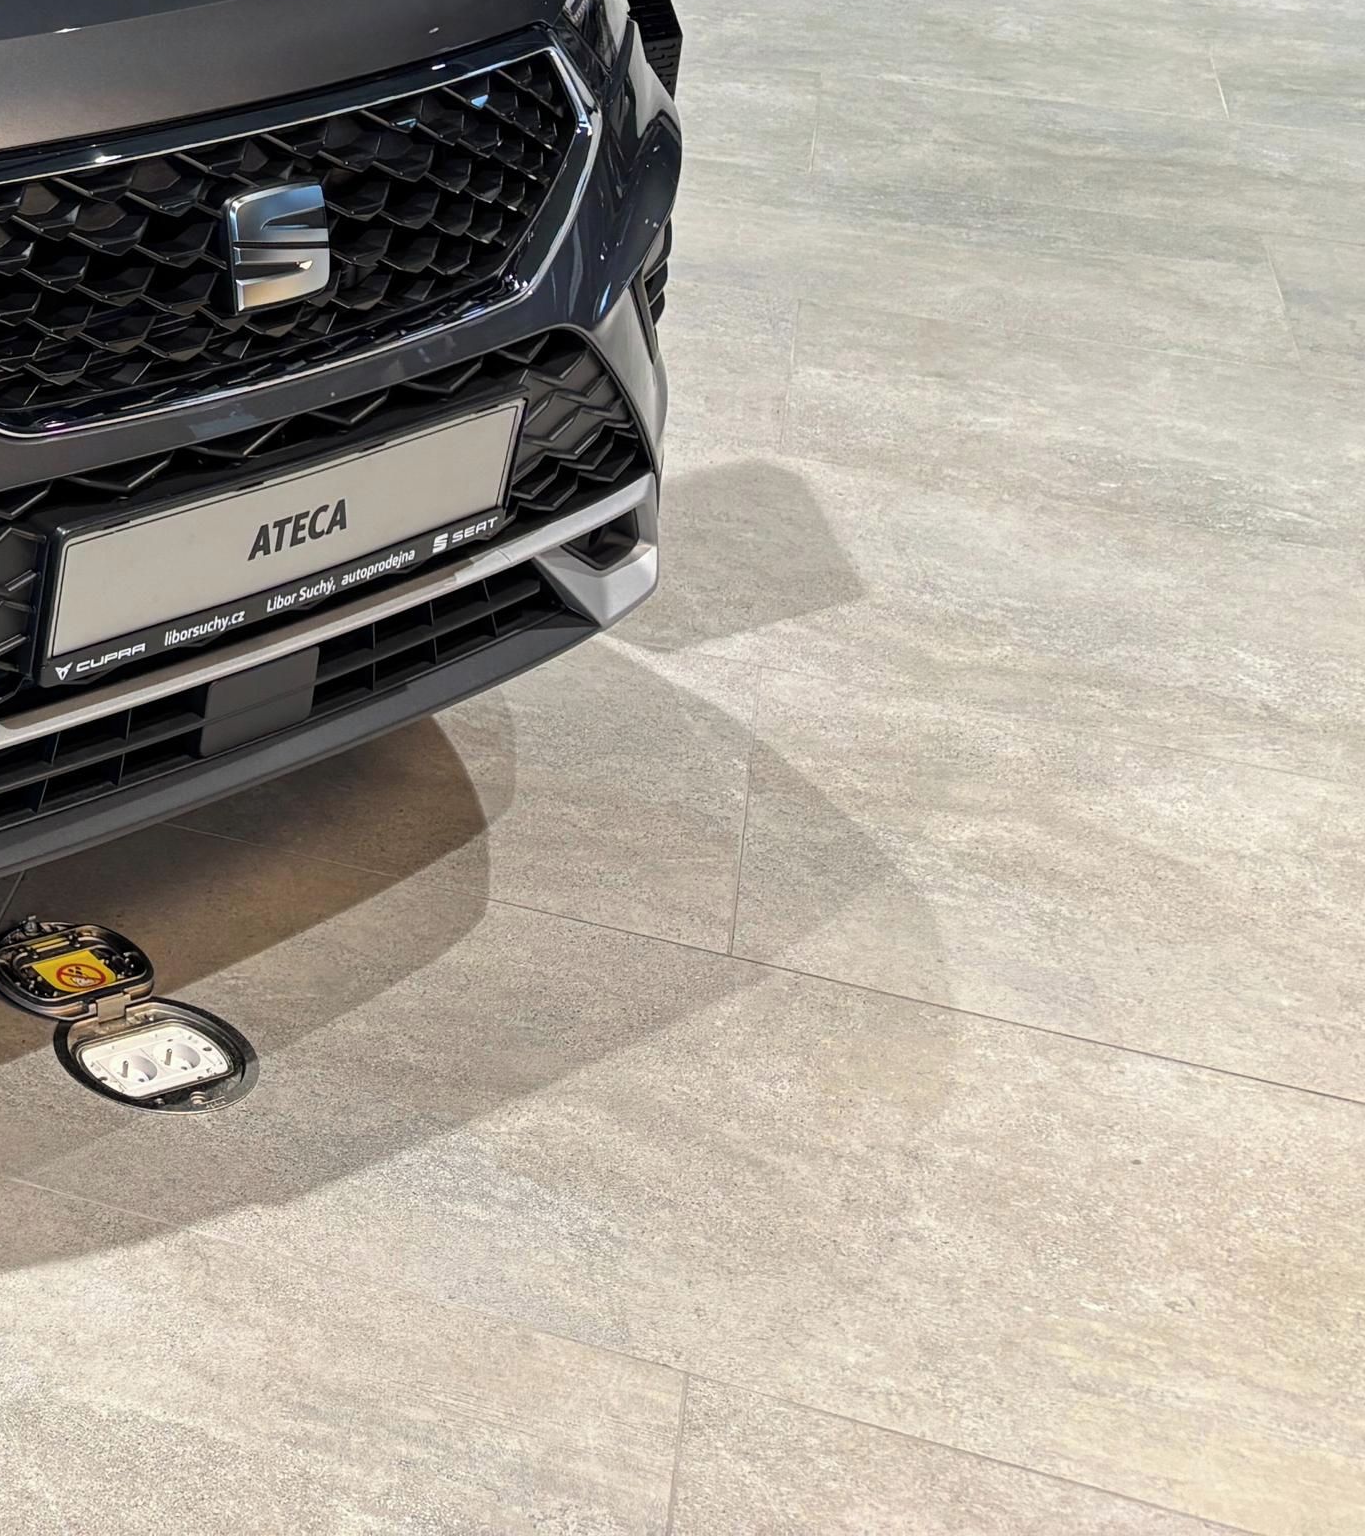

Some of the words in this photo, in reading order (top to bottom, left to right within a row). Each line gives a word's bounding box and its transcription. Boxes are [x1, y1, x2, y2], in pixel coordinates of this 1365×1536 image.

[247, 498, 348, 562] ATECA
[76, 642, 147, 673] CUPRA
[164, 610, 246, 647] liborsuchy.cz
[266, 593, 298, 613] Libor
[341, 549, 416, 586] autoprodejna
[452, 516, 499, 544] SEAT
